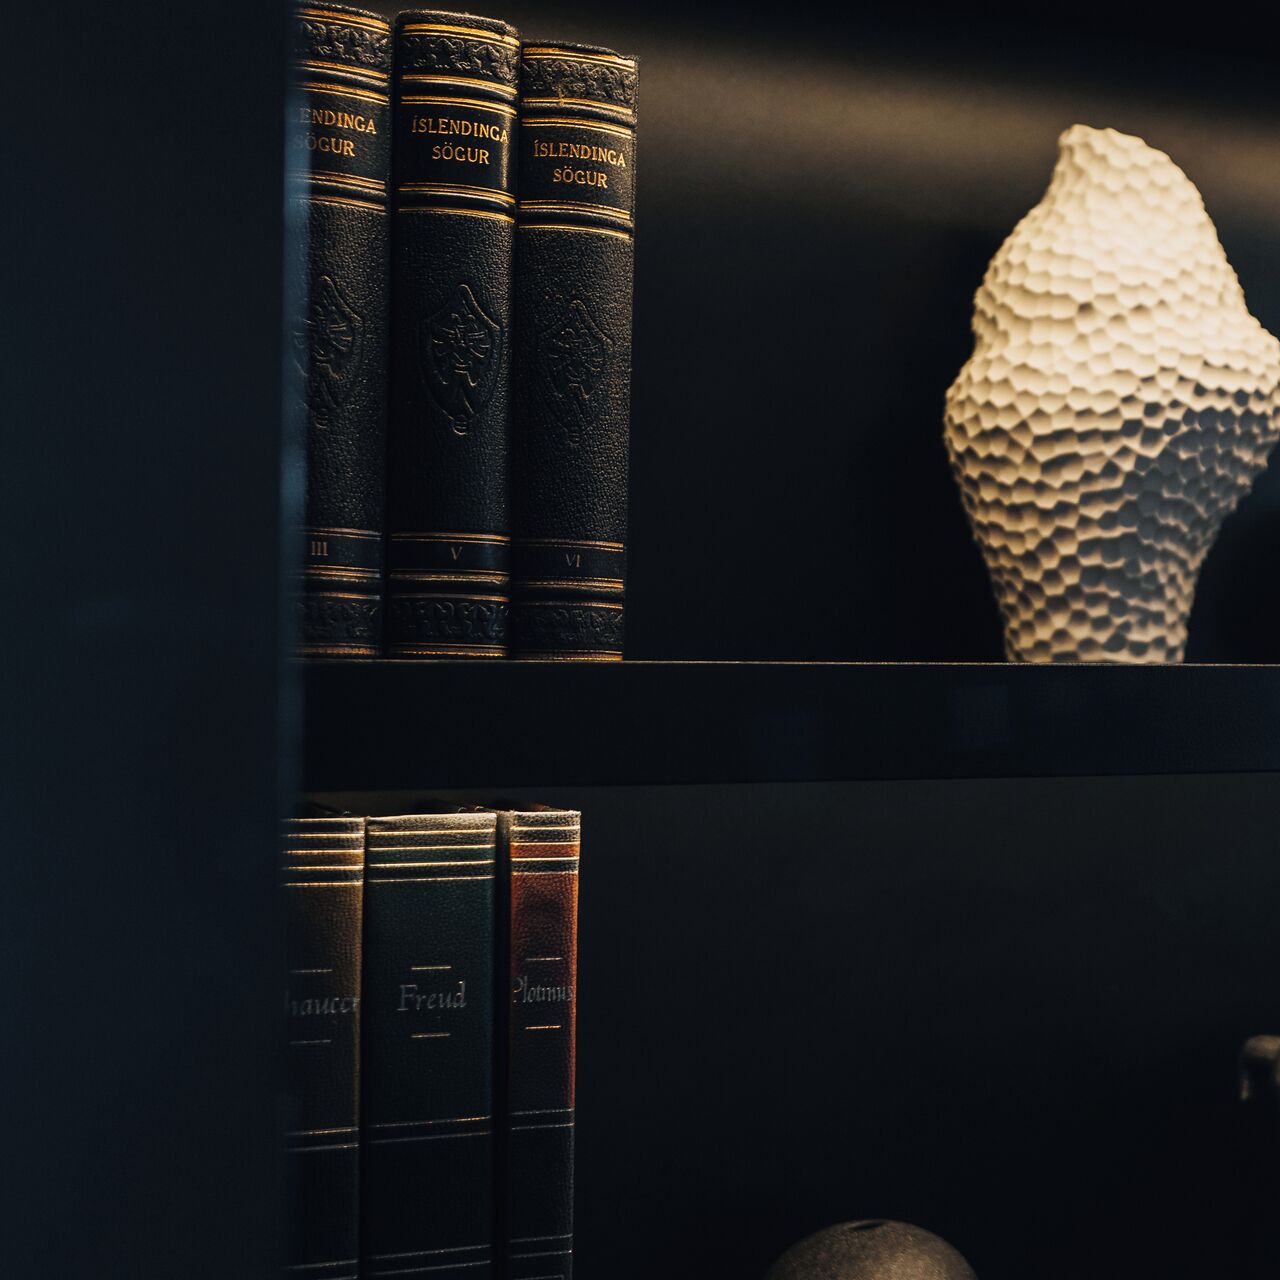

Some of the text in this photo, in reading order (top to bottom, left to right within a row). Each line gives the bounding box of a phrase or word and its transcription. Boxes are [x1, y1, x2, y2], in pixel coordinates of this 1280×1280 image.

[294, 107, 377, 135] ENDINGA
[411, 113, 509, 144] ÍSLENDINGA
[431, 141, 490, 165] SÖGUR
[533, 140, 627, 167] ÍSLENDINGA
[552, 165, 609, 189] SÖGUR
[311, 541, 329, 557] III
[450, 545, 464, 561] V
[564, 553, 582, 568] VI
[396, 976, 468, 1012] Freud
